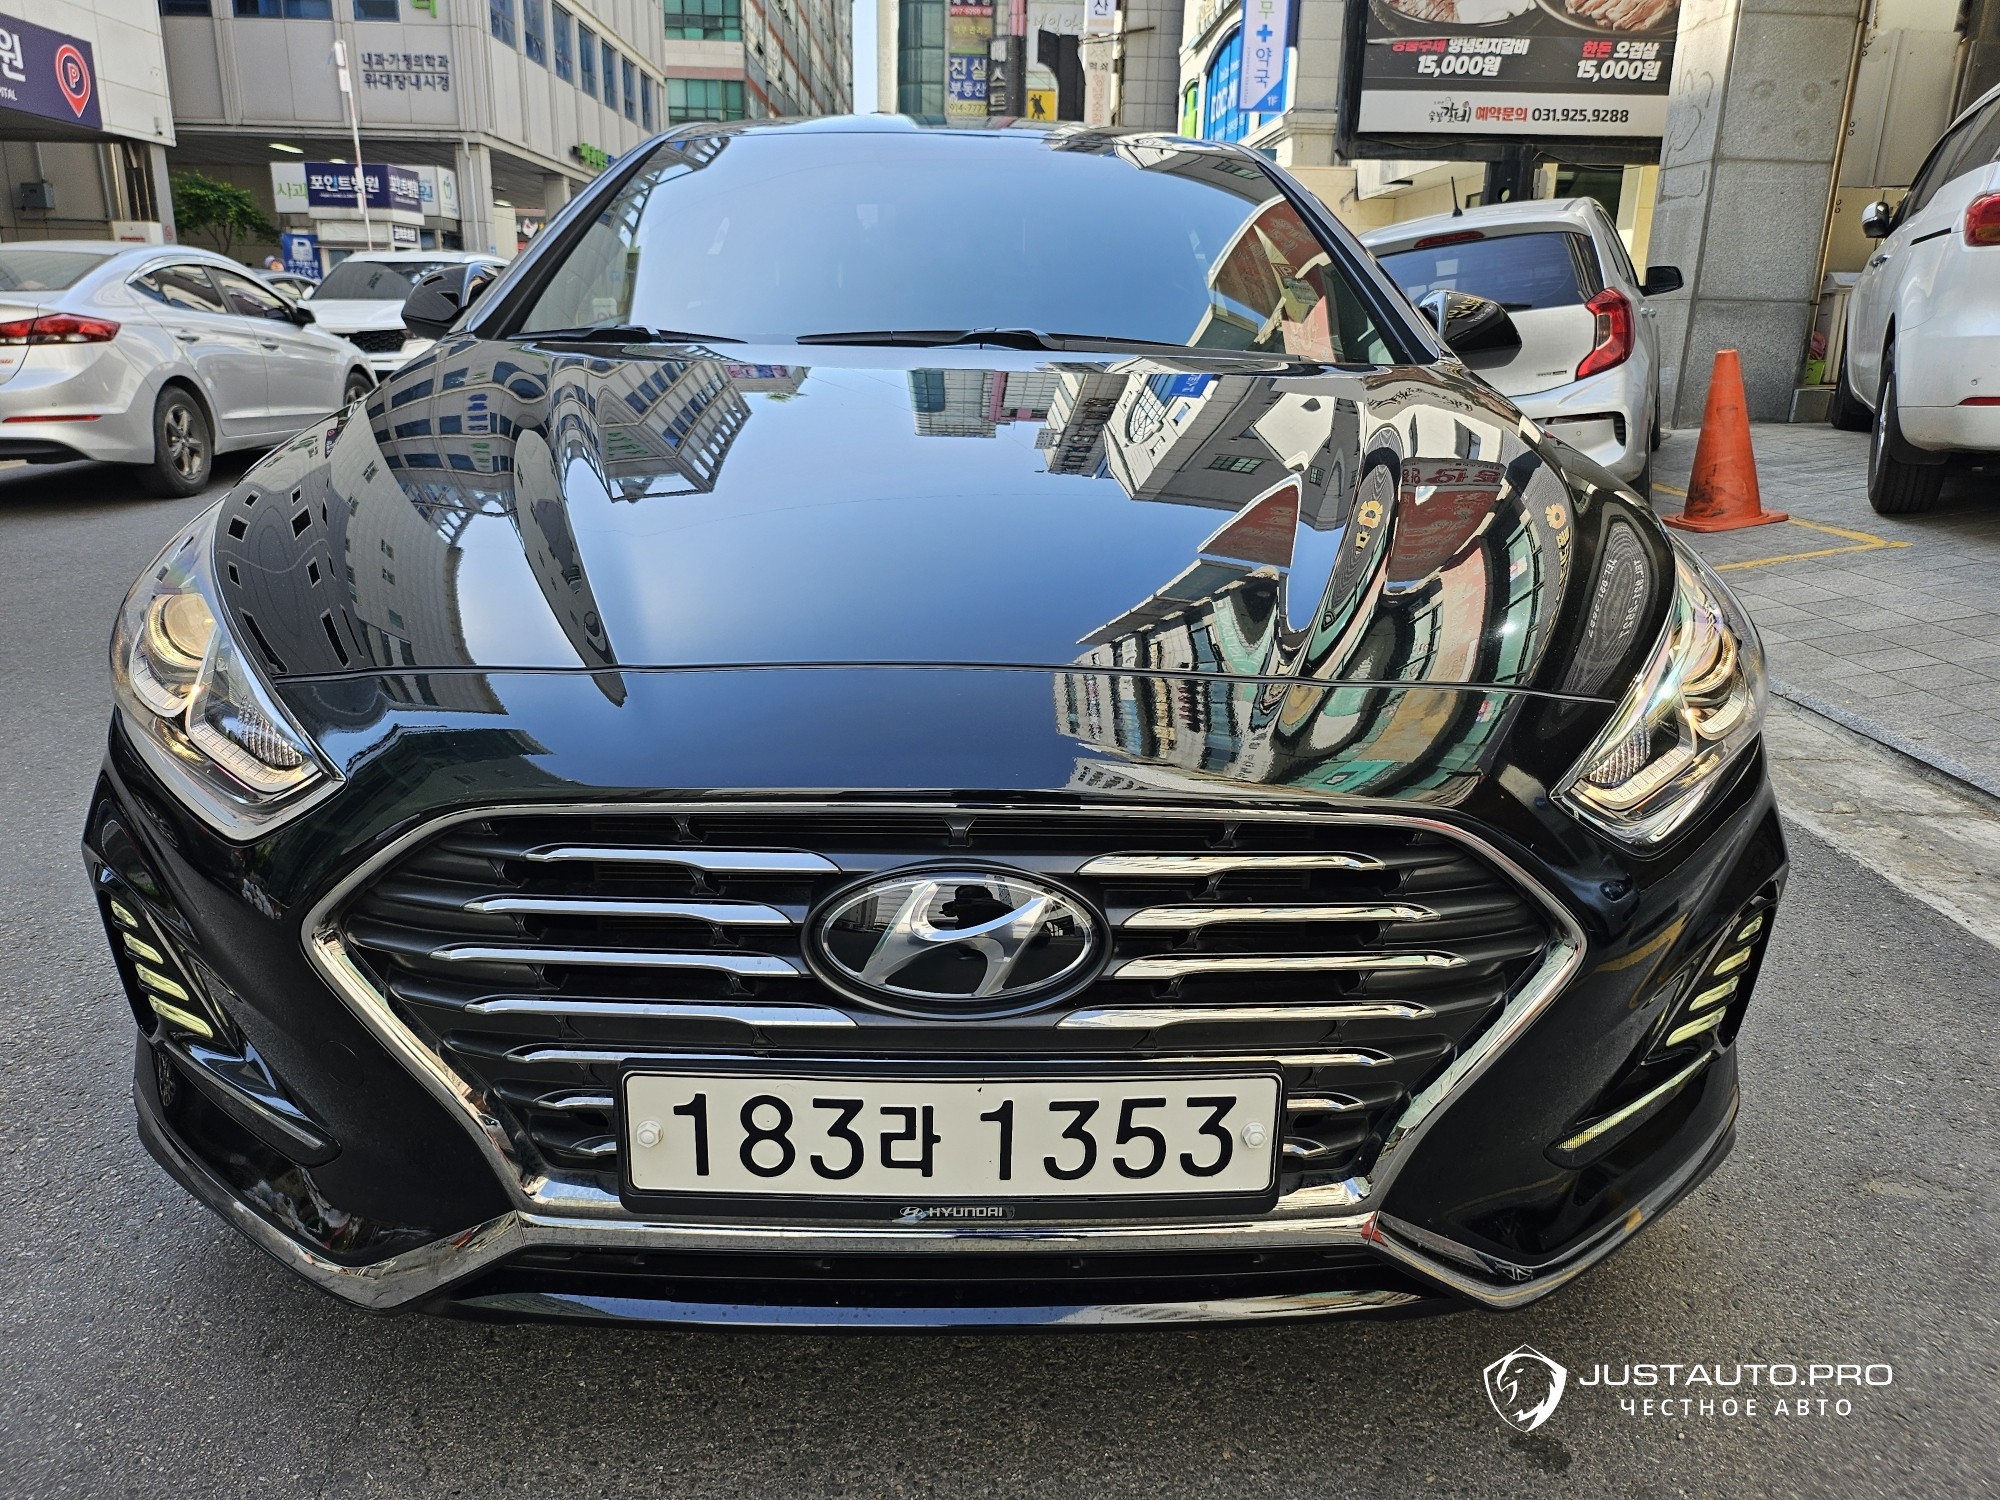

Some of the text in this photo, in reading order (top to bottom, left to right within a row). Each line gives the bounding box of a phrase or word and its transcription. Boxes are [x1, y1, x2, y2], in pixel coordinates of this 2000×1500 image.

[1448, 38, 1530, 55] 양념돼지갈비
[1582, 41, 1660, 59] 한돈 오겹살
[950, 58, 987, 80] 진실
[1255, 47, 1273, 88] 약국
[1417, 55, 1502, 78] 15,000원
[1576, 60, 1661, 82] 15,000원
[950, 80, 987, 97] 부동산
[1475, 106, 1528, 122] 예약문의
[1532, 108, 1629, 123] 031.925.9288
[672, 1092, 1238, 1181] 183라 1353
[929, 1207, 1003, 1217] HYUNDAI
